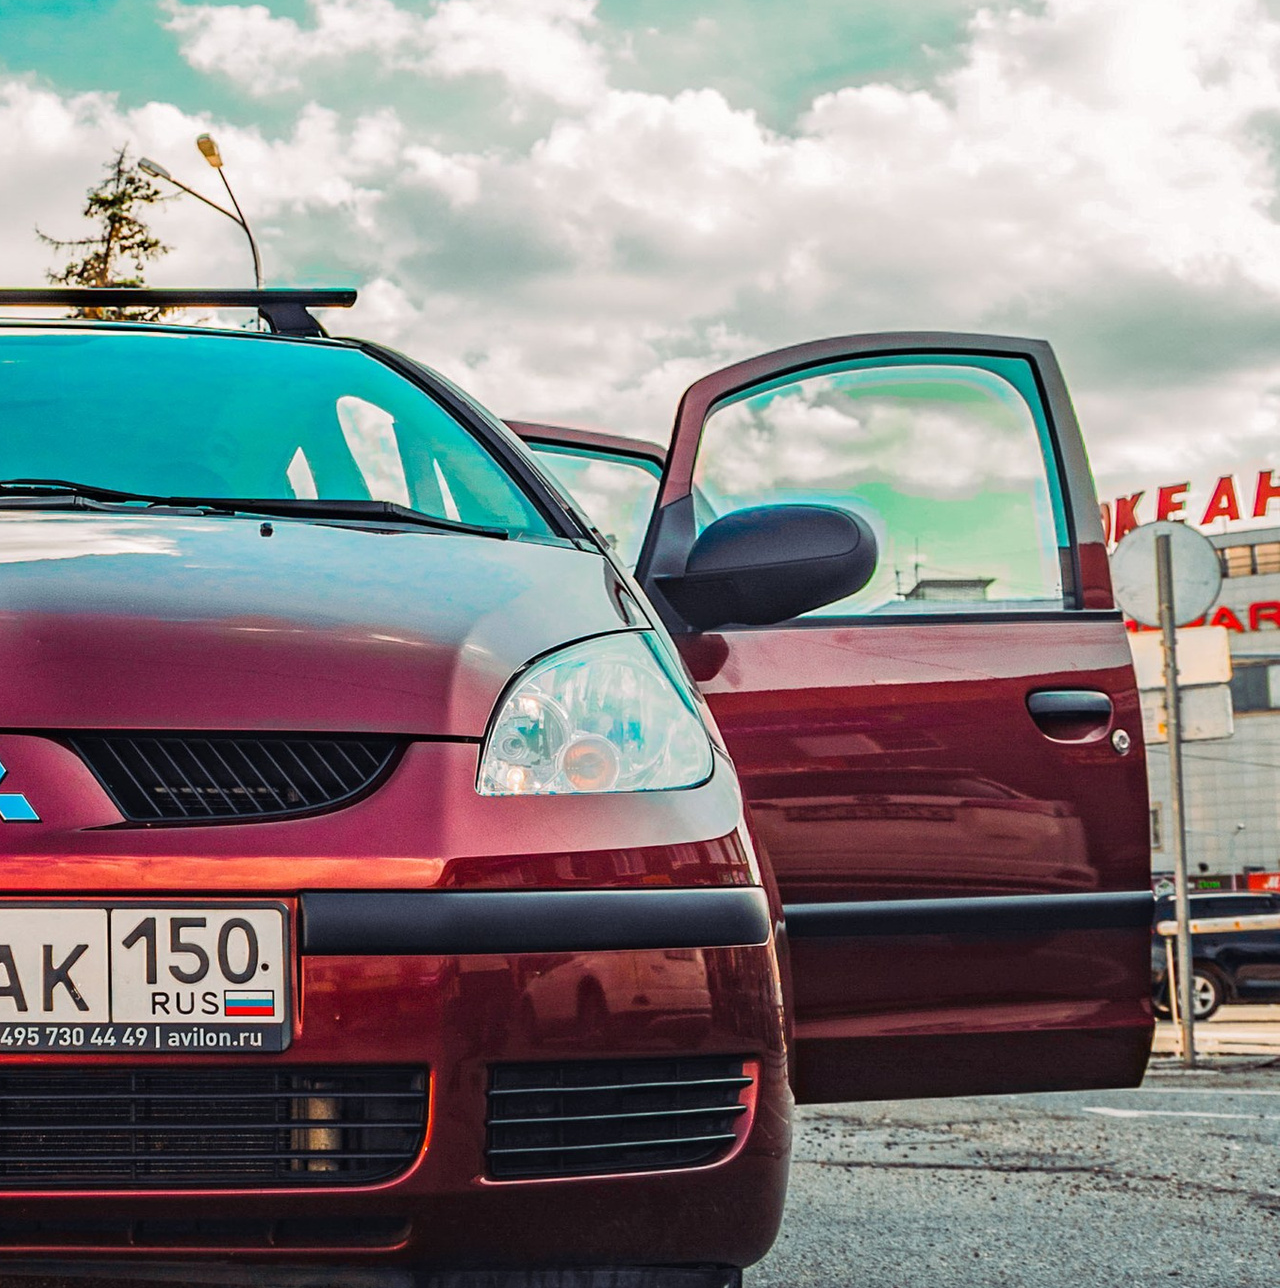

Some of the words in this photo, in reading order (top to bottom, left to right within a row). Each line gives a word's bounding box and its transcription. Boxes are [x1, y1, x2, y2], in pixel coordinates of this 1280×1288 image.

[121, 916, 259, 985] 150
[151, 991, 220, 1015] RUS
[0, 1026, 40, 1047] 495
[45, 1026, 85, 1047] 730
[90, 1026, 117, 1047] 44
[121, 1026, 148, 1047] 49
[167, 1026, 263, 1048] avilon.ru
